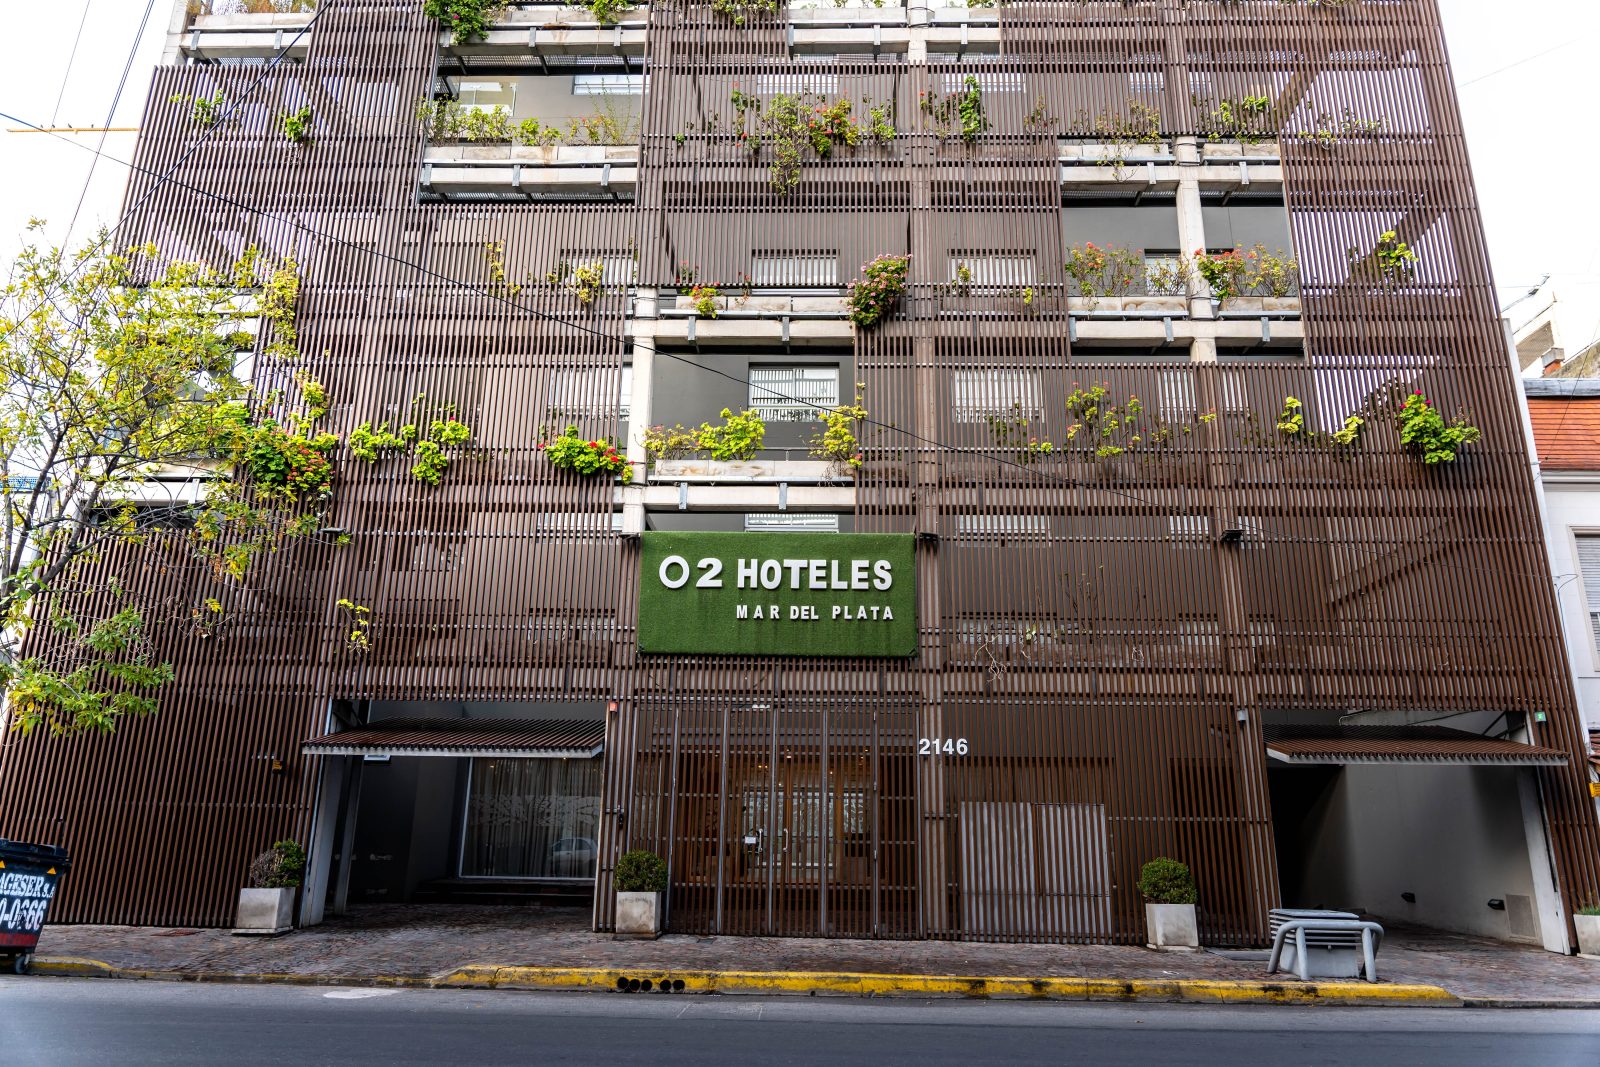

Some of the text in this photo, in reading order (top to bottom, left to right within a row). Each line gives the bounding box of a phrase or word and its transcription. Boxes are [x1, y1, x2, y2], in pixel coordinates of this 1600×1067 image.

[737, 558, 893, 591] HOTELES
[736, 604, 894, 620] MAR DEL PLATA
[918, 738, 968, 755] 2146
